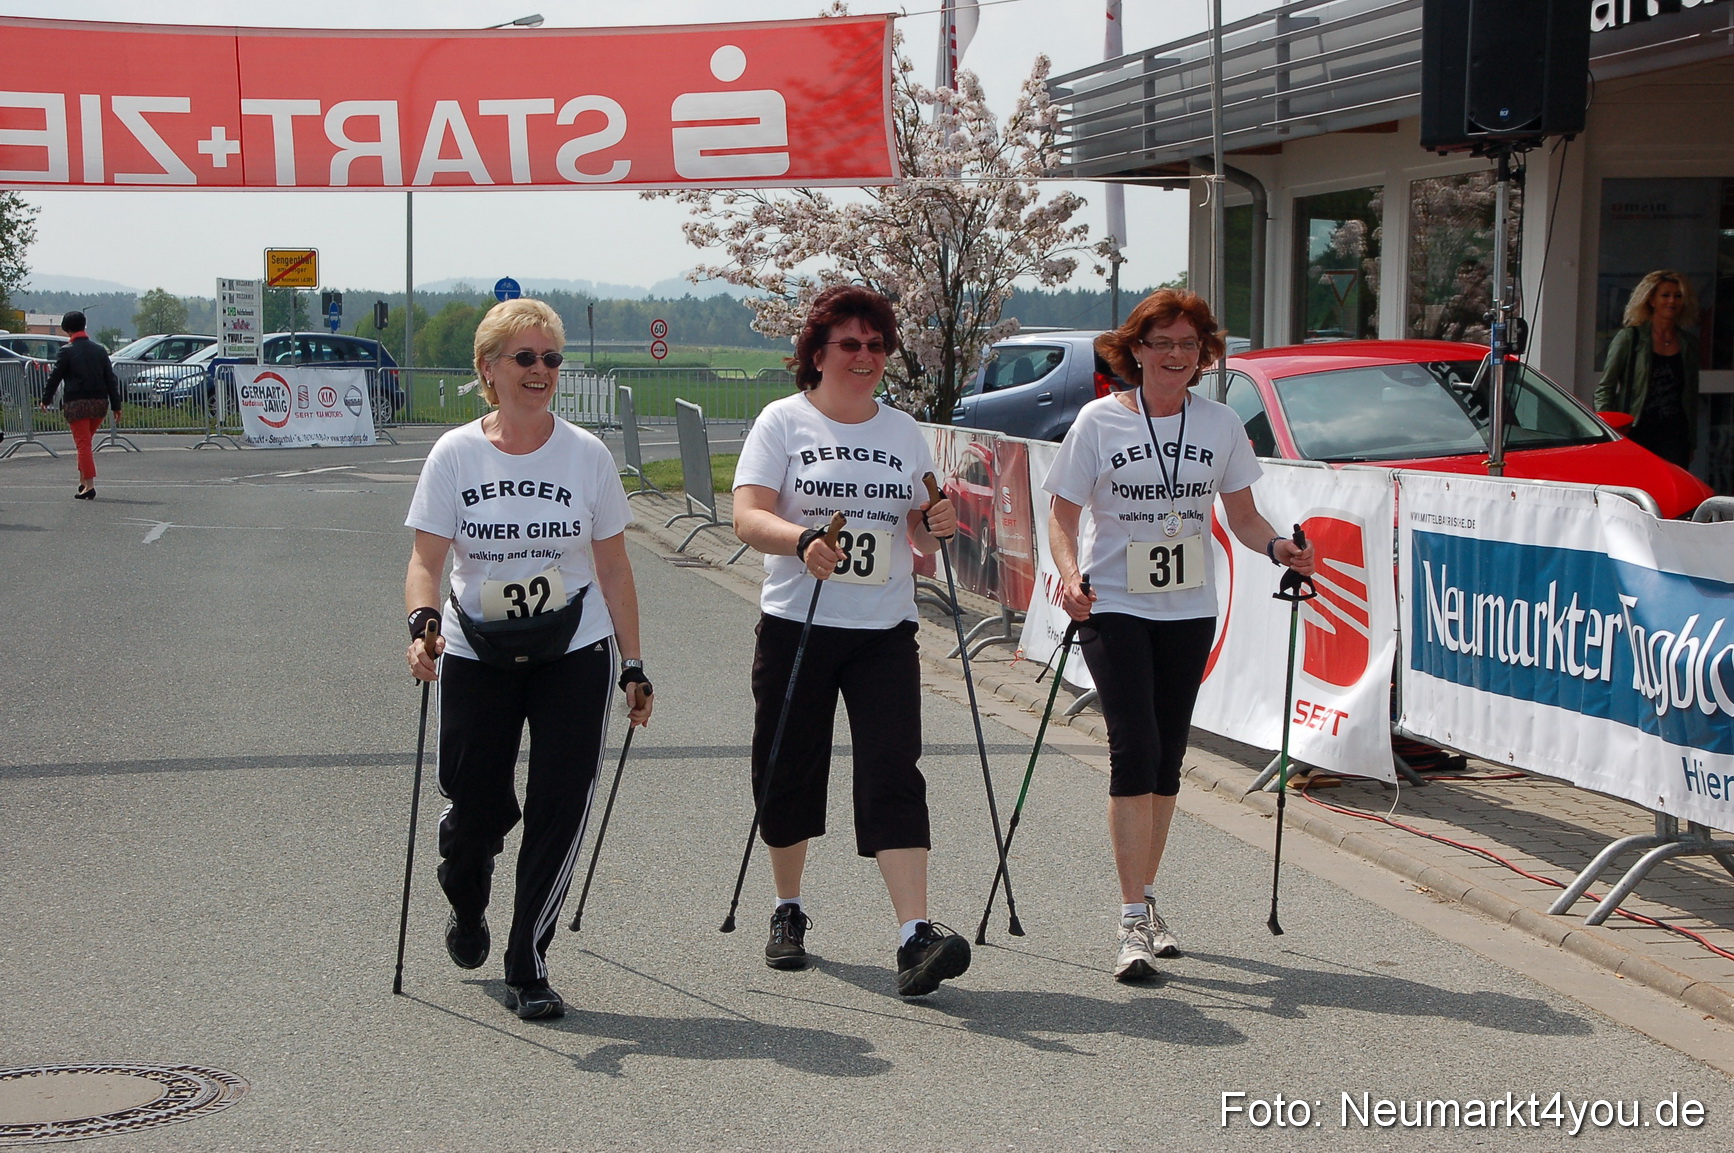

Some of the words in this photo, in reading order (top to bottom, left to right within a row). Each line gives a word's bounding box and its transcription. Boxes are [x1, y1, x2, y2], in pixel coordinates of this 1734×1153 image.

[654, 324, 664, 333] 60
[241, 385, 281, 399] GERHART
[321, 391, 334, 403] KIA
[800, 446, 903, 473] BERGER
[461, 480, 572, 507] BERGER
[794, 477, 858, 498] POWER
[864, 483, 913, 500] GIRLS
[1111, 480, 1168, 501] POWER
[801, 507, 841, 516] walkin
[844, 509, 864, 519] and
[867, 510, 899, 526] talking
[1119, 511, 1154, 523] walking
[461, 518, 520, 540] POWER
[526, 520, 581, 539] GIRLS
[468, 551, 504, 563] walking
[507, 549, 527, 560] and
[531, 549, 564, 560] talkin
[1149, 543, 1184, 588] 31
[503, 576, 555, 620] 32
[1422, 560, 1622, 682] Neumarkter
